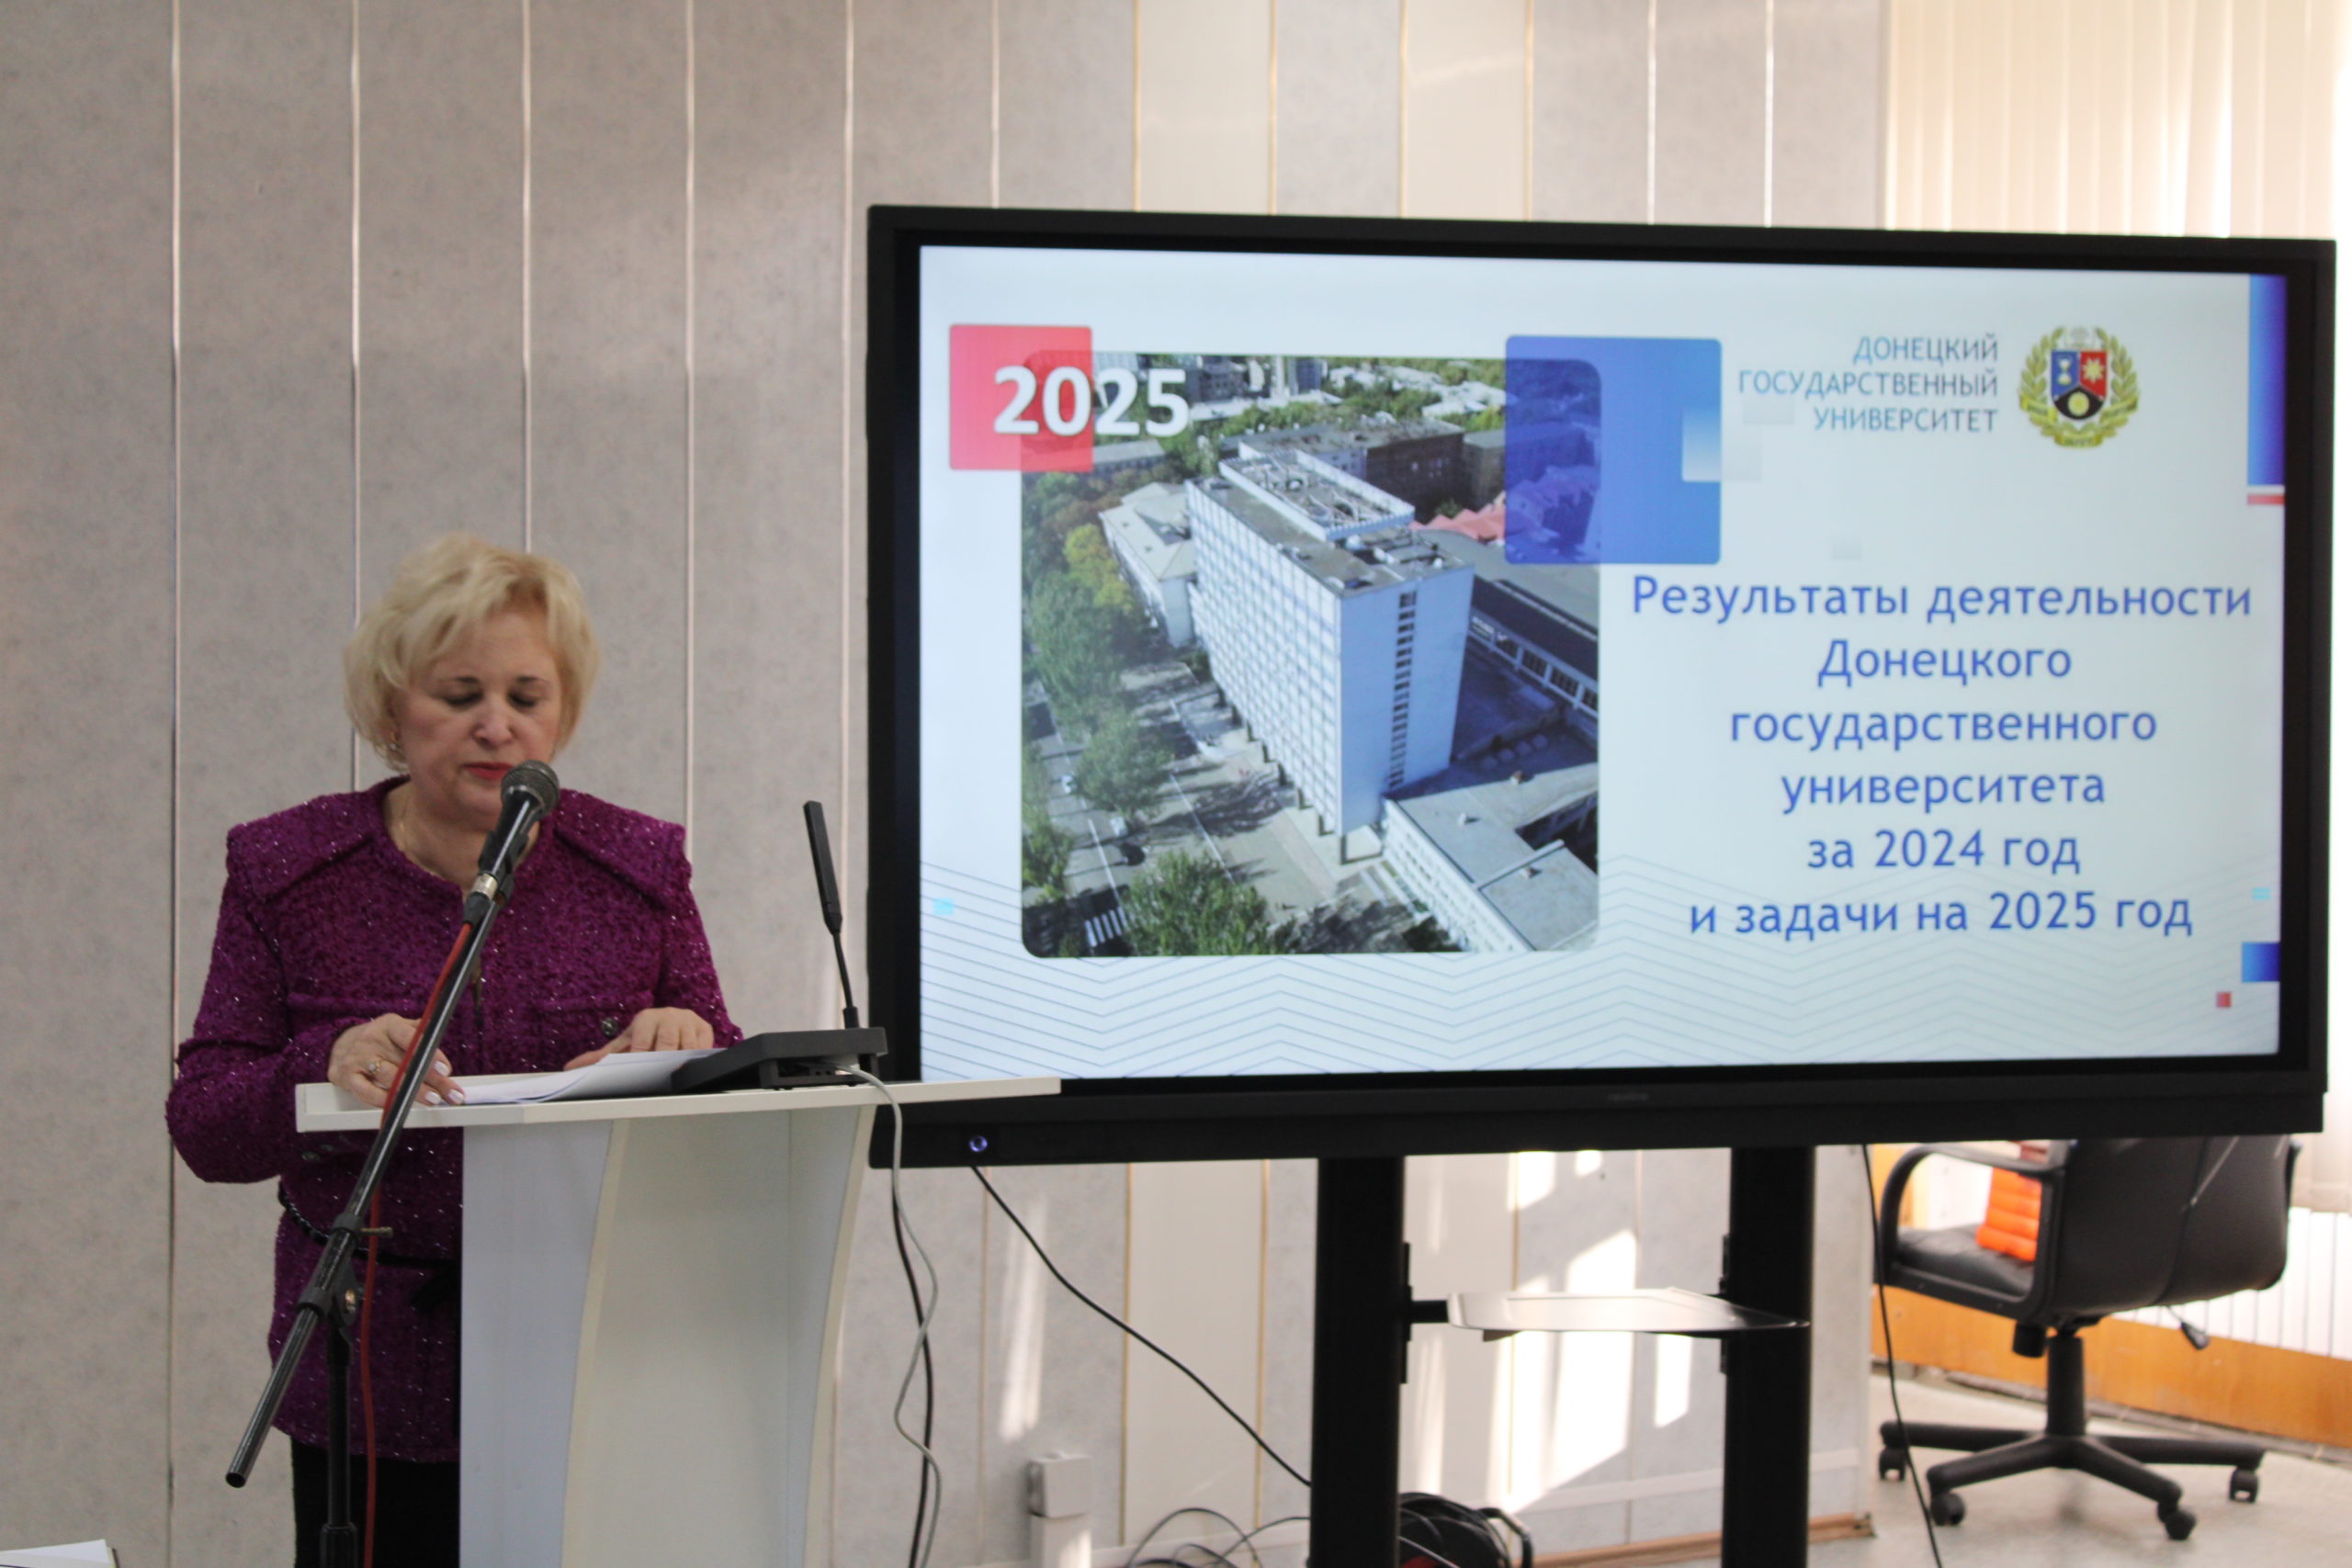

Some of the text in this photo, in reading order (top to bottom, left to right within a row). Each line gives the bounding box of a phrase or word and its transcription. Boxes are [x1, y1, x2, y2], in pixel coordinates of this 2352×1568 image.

[1852, 333, 1999, 363] ДОНЕЦКИЙ
[993, 365, 1190, 437] 2025
[1738, 367, 1999, 398] ГОСУДАРСТВЕННЫЙ
[1814, 407, 1999, 433] УНИВЕРСИТЕТ
[1634, 574, 2252, 624] Результаты деятельности
[1817, 638, 2073, 687] Донецкого
[1732, 711, 2158, 751] государственного
[1781, 773, 2106, 815] университета
[1807, 829, 2081, 874] за 2024 год
[1690, 891, 2193, 942] и задачи на 2025 год
